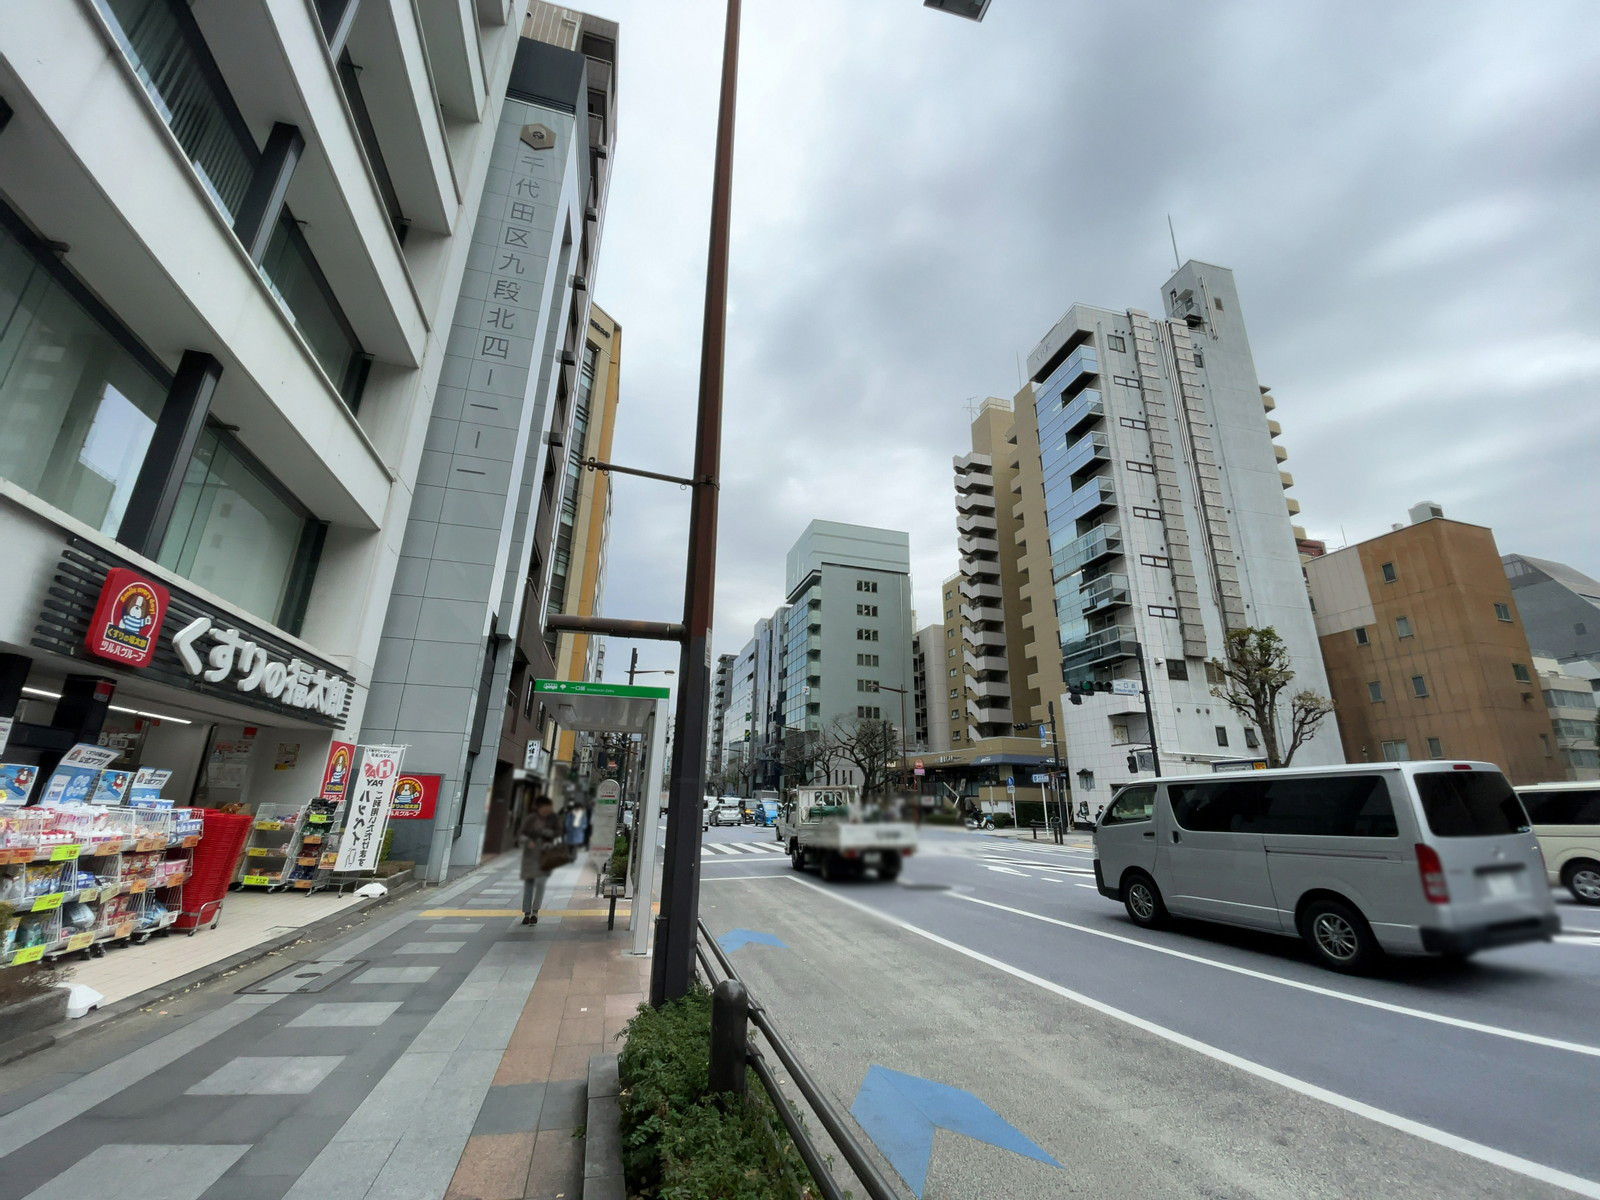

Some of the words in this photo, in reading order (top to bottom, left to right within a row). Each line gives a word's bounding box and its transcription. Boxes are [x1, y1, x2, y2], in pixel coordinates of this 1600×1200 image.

[99, 641, 146, 662] ツルハグループ
[172, 617, 348, 718] くすりの福太郎
